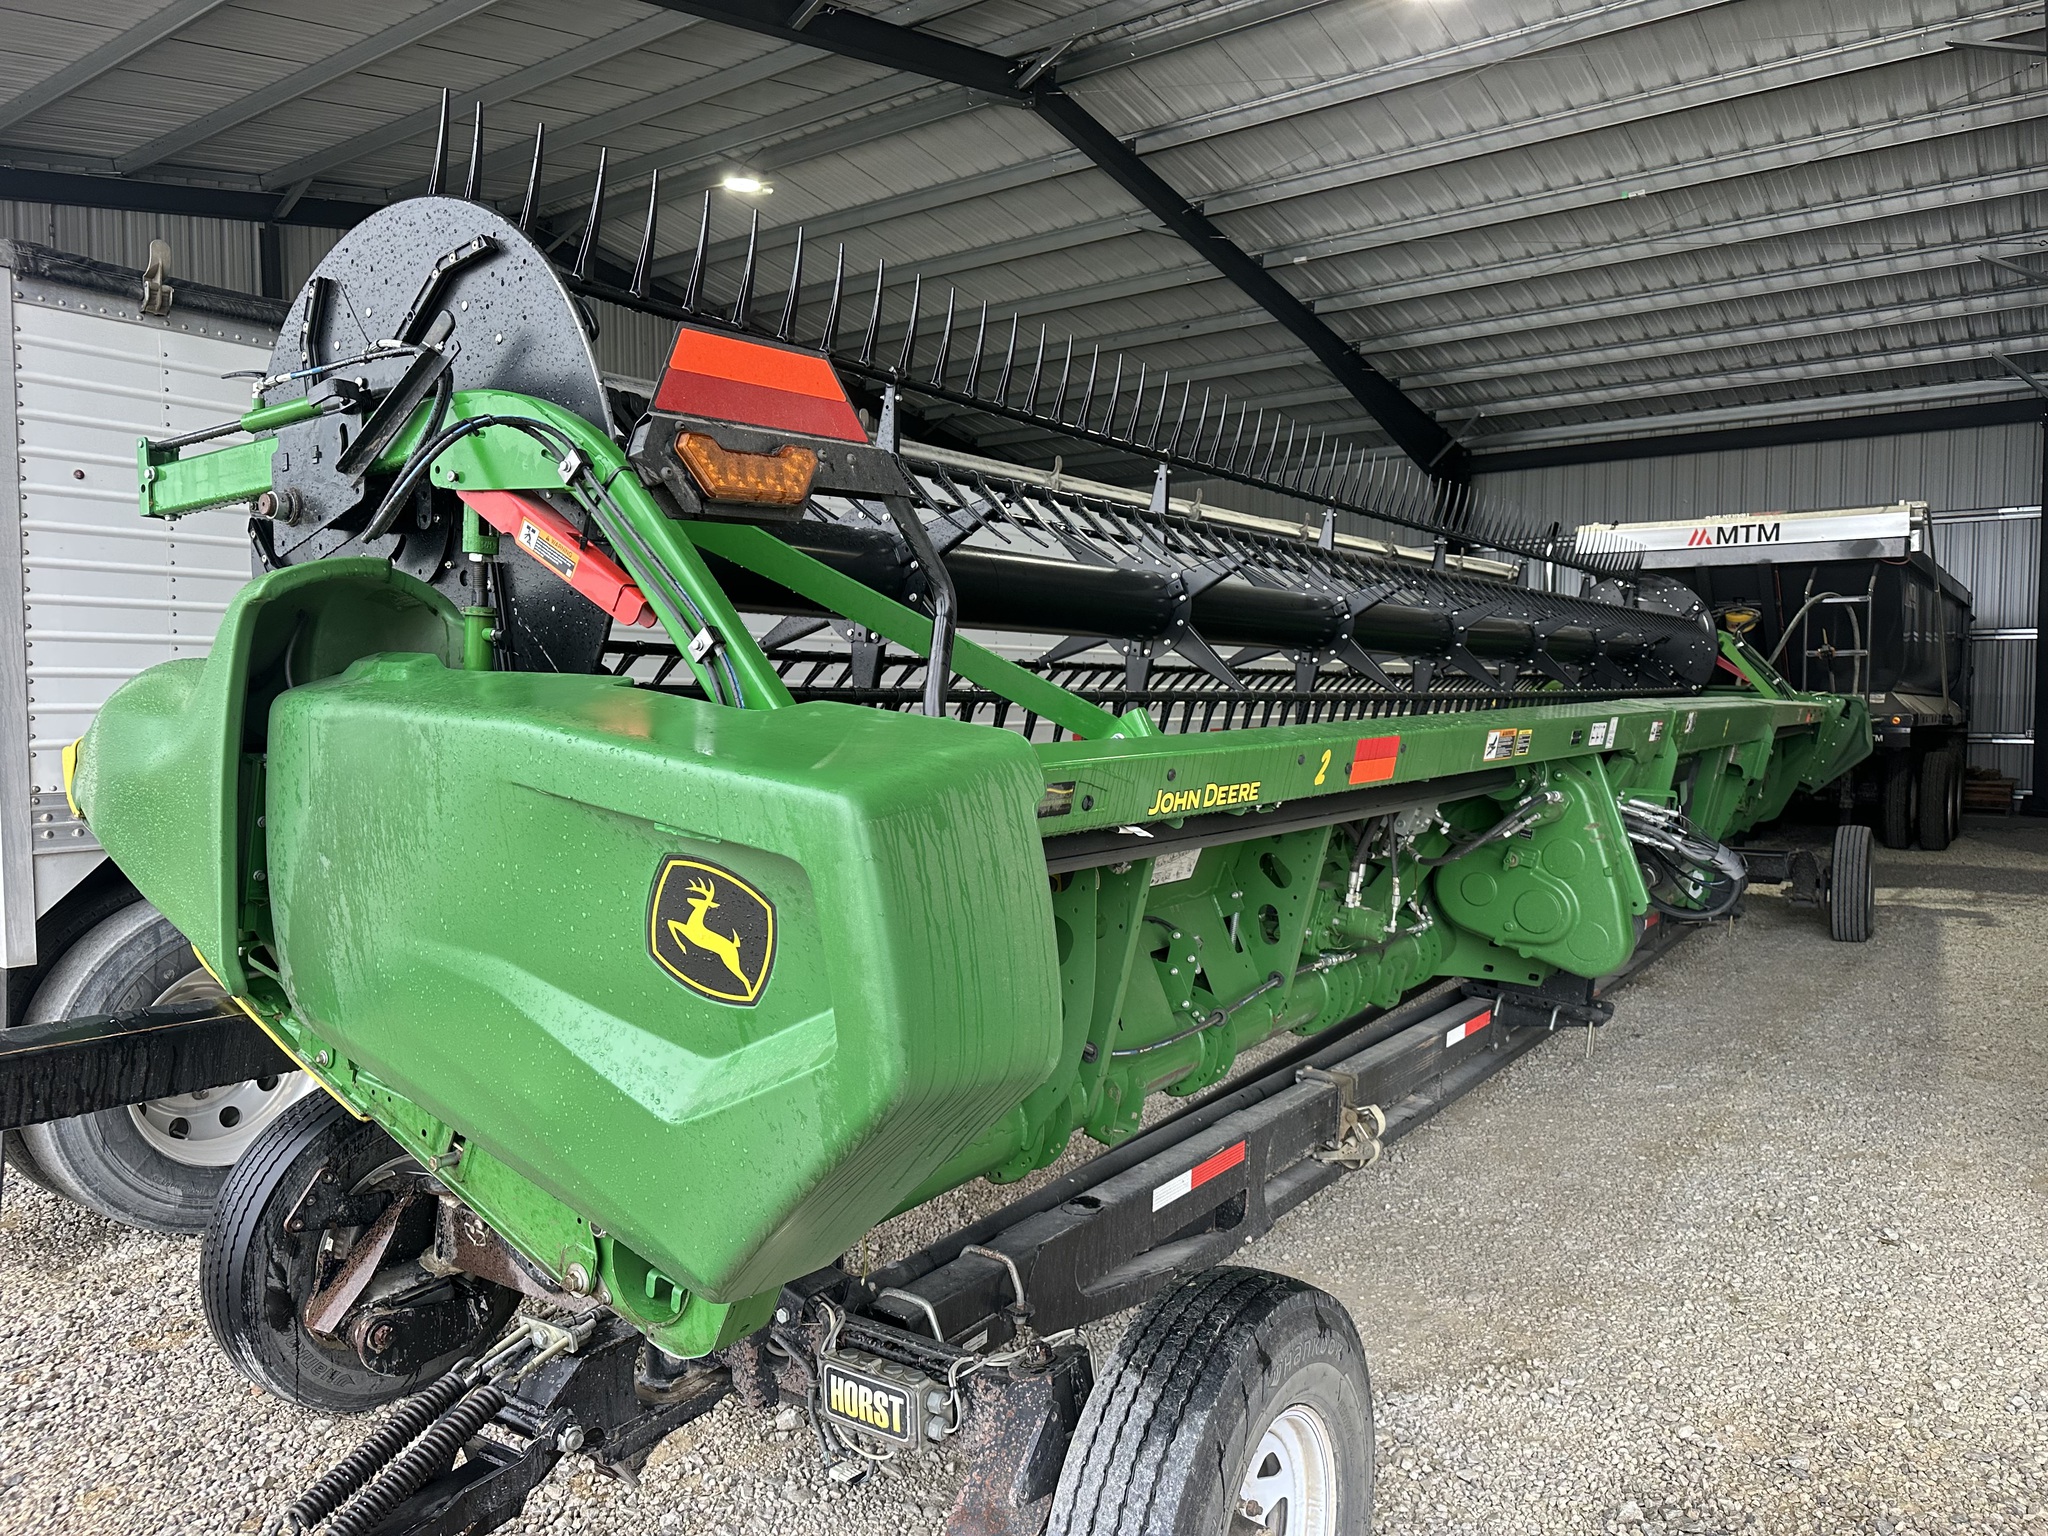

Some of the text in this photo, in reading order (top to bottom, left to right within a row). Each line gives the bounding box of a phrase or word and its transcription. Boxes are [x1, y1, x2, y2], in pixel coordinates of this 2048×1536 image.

[551, 537, 573, 558] WARNING
[1716, 523, 1780, 545] MTM
[1314, 749, 1332, 787] 2
[1148, 780, 1261, 816] JOHN DEERE
[830, 1374, 904, 1434] HORST
